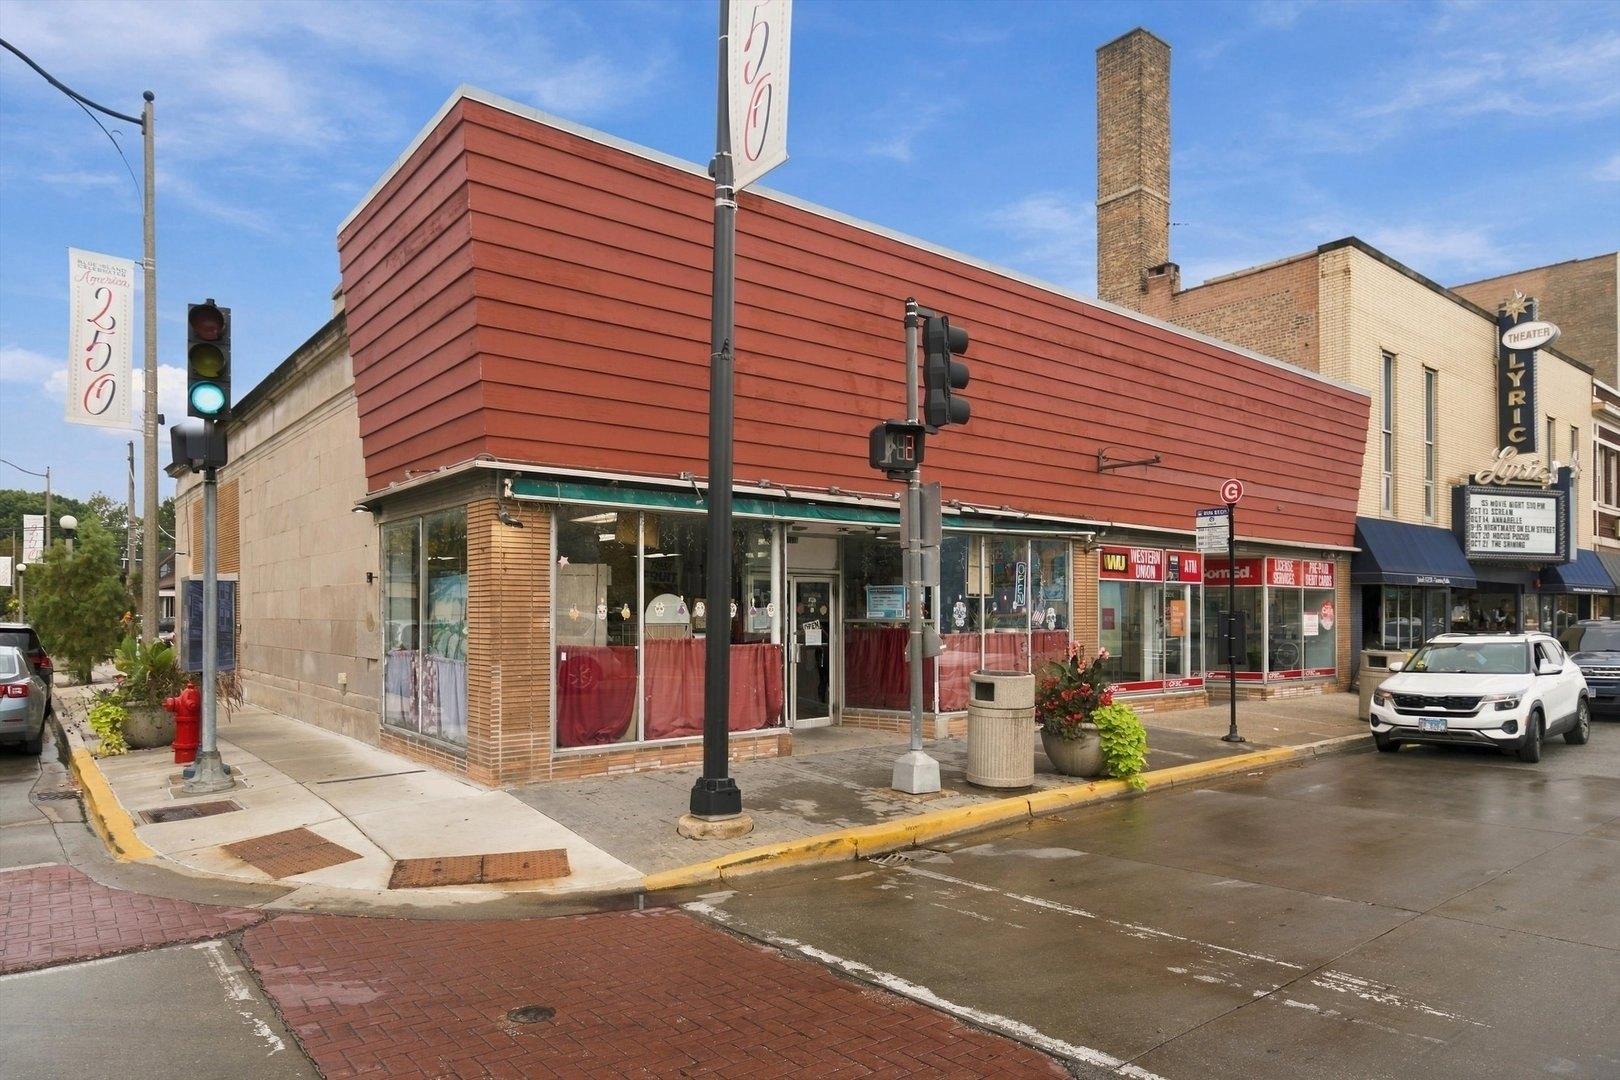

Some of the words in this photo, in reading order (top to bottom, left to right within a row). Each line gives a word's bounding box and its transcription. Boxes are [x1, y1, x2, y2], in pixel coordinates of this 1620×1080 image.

[744, 0, 773, 161] 50
[1507, 327, 1551, 344] THEATER
[84, 286, 117, 416] 250
[1506, 352, 1527, 443] LYRIC
[1475, 446, 1551, 486] Lyric
[1224, 483, 1238, 499] G
[1491, 508, 1513, 516] SCREAM
[1509, 501, 1525, 509] NIGHT
[1484, 524, 1516, 532] NIGHTMARE
[1512, 533, 1530, 541] POCUS
[1130, 548, 1161, 565] WESTERN
[1135, 564, 1156, 579] UNION
[1184, 559, 1198, 574] ATM
[1274, 560, 1294, 572] LICENSE
[1308, 562, 1329, 574] PRE-PAID
[1017, 564, 1025, 604] OPEN
[1272, 571, 1295, 585] SERVICES
[1305, 573, 1318, 586] DEBIT
[1318, 574, 1333, 587] CARDS
[803, 620, 820, 630] OPEN
